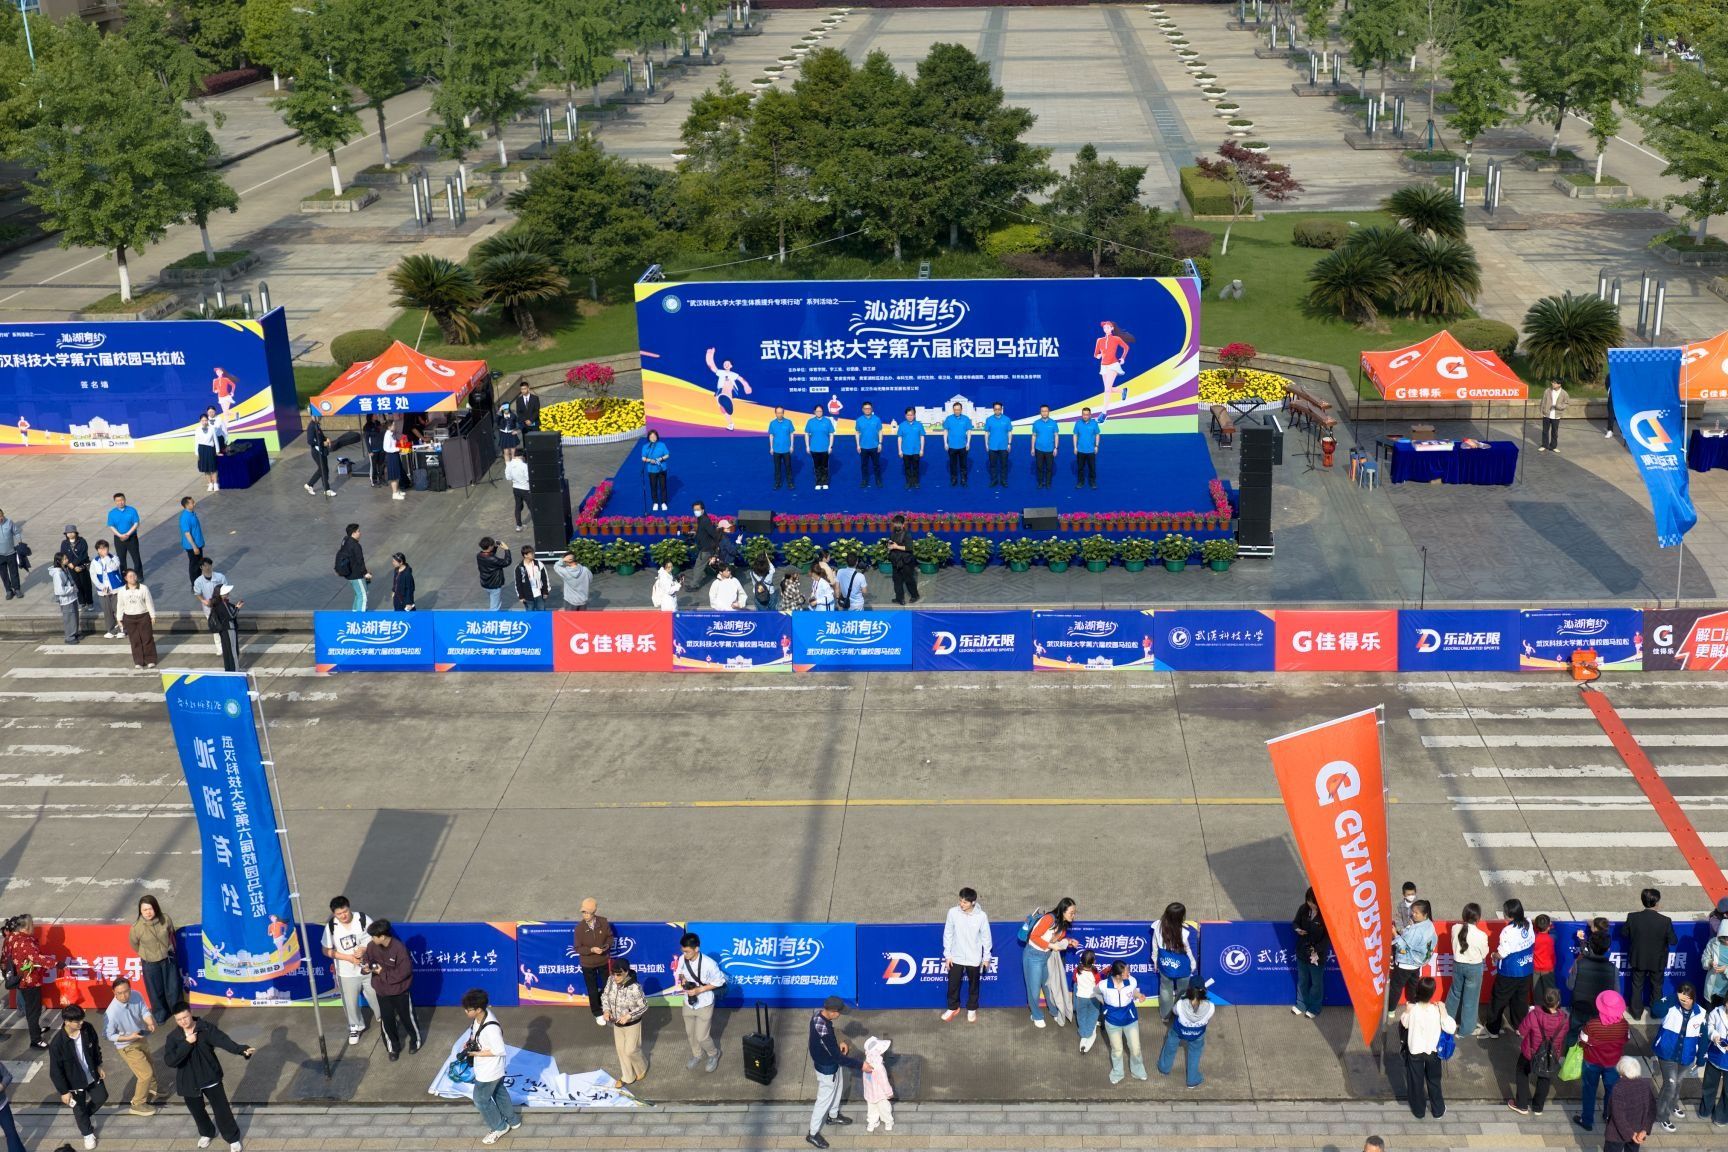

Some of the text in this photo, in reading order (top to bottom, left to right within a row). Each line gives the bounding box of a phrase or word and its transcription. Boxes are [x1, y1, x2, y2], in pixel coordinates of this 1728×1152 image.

[862, 297, 964, 323] 沁湖有约
[59, 332, 104, 345] 沁湖有约
[760, 338, 1059, 360] 武汉科技大学第六届校园马拉松
[1436, 356, 1469, 379] G
[80, 381, 109, 389] 签名墙
[376, 366, 409, 391] G
[1408, 388, 1442, 398] 佳得乐
[1469, 389, 1520, 397] GATORADE
[358, 396, 410, 412] 音控处
[345, 619, 406, 636] 沁湖有约
[465, 619, 526, 636] 沁湖有约
[711, 620, 754, 632] 沁湖有约
[825, 619, 886, 636] 沁湖有约
[1072, 620, 1116, 632] 沁湖有约
[1562, 618, 1606, 631] 沁湖有约
[592, 633, 657, 653] 佳得乐
[686, 640, 777, 649] 武汉科技大学第六届校园马拉松
[959, 634, 1015, 647] 乐动无限
[1046, 640, 1139, 649] 武汉科技大学第六届校园马拉松
[1315, 631, 1381, 651] 佳得乐
[1443, 632, 1501, 645] 乐动无限
[1535, 639, 1630, 648] 武汉科技大学第六届校园马拉松
[327, 648, 422, 656] 武汉科技大学第六届校园马拉松
[447, 648, 541, 656] 武汉科技大学第六届校园马拉松
[806, 648, 902, 656] 武汉科技大学第六届校园马拉松
[1652, 647, 1674, 655] 佳得乐
[731, 936, 818, 958] 沁湖有约
[1084, 934, 1142, 951] 沁湖有约
